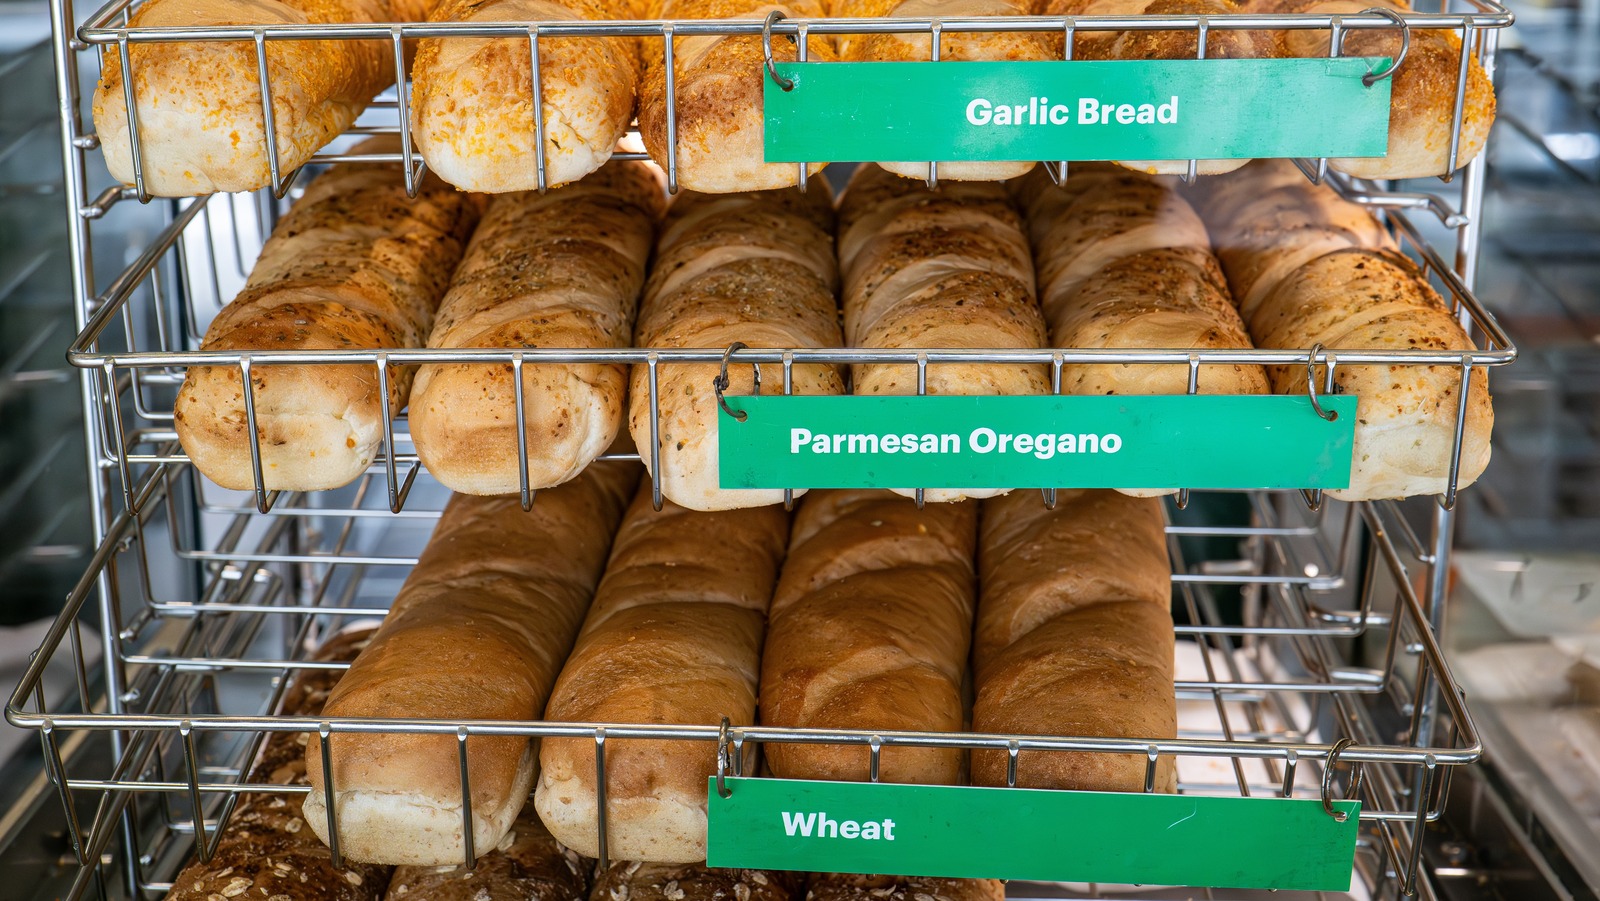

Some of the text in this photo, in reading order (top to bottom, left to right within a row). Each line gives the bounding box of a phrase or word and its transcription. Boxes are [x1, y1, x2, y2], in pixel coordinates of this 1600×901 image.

[965, 95, 1179, 126] Garlic Bread
[790, 427, 1122, 460] Parmesan Oregano
[781, 811, 896, 841] Wheat
